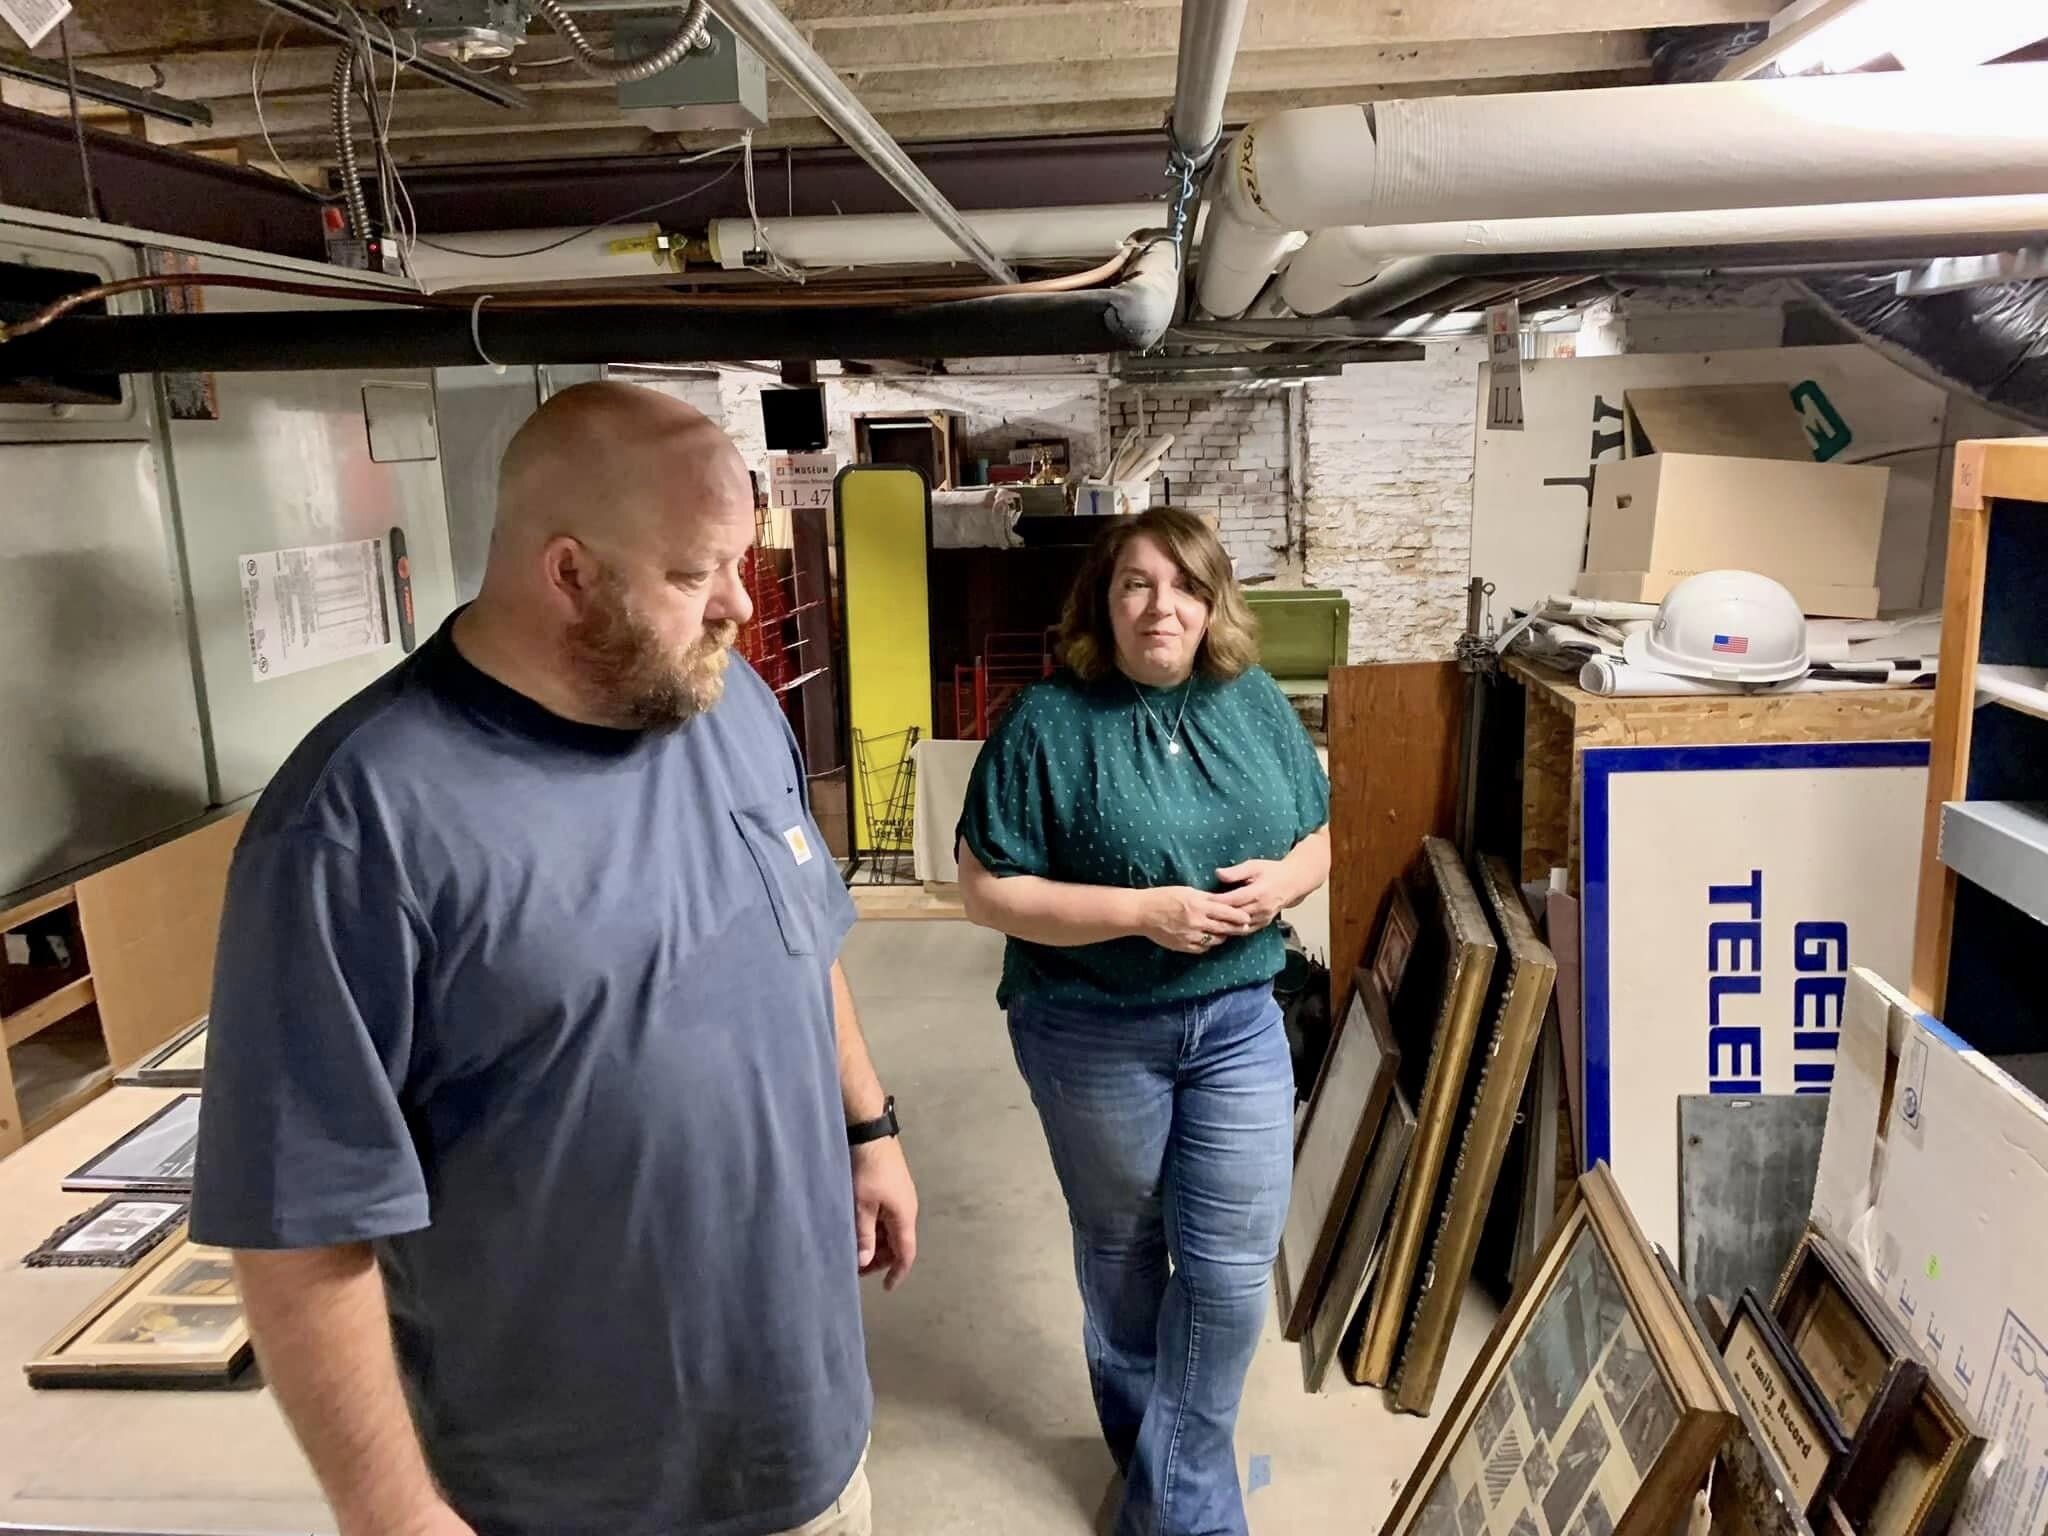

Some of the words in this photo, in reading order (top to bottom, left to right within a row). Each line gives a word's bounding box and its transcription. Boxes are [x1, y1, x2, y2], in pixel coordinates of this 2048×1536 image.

[780, 489, 805, 506] LL
[811, 488, 831, 505] 47
[795, 466, 829, 474] MUSEUM
[1708, 869, 1762, 1094] TELE
[1793, 921, 1848, 1094] GEN
[1746, 1346, 1776, 1400] Family
[1777, 1398, 1811, 1459] Record
